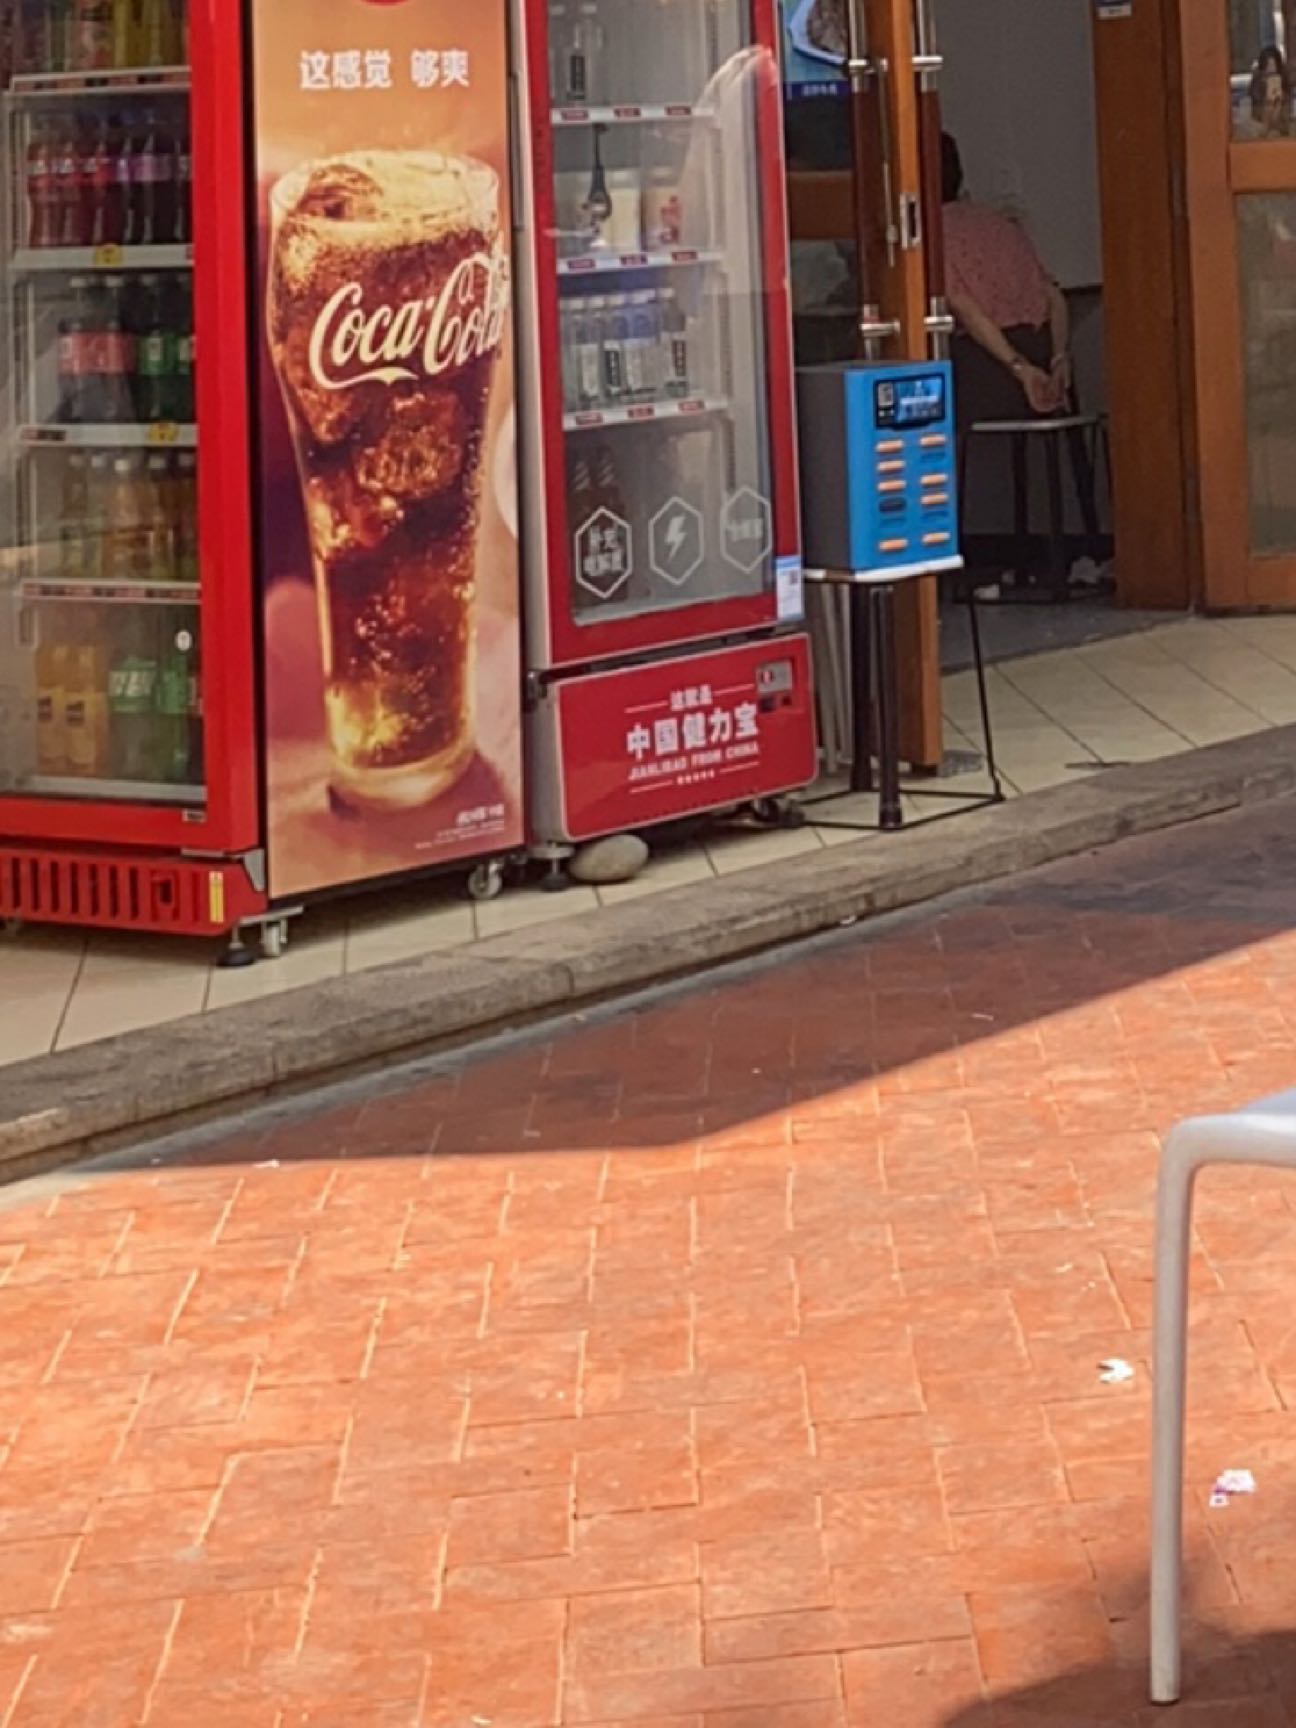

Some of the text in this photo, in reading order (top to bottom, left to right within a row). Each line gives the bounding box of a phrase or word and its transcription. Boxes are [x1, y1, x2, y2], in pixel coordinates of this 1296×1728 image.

[299, 48, 470, 91] 这感觉 够爽
